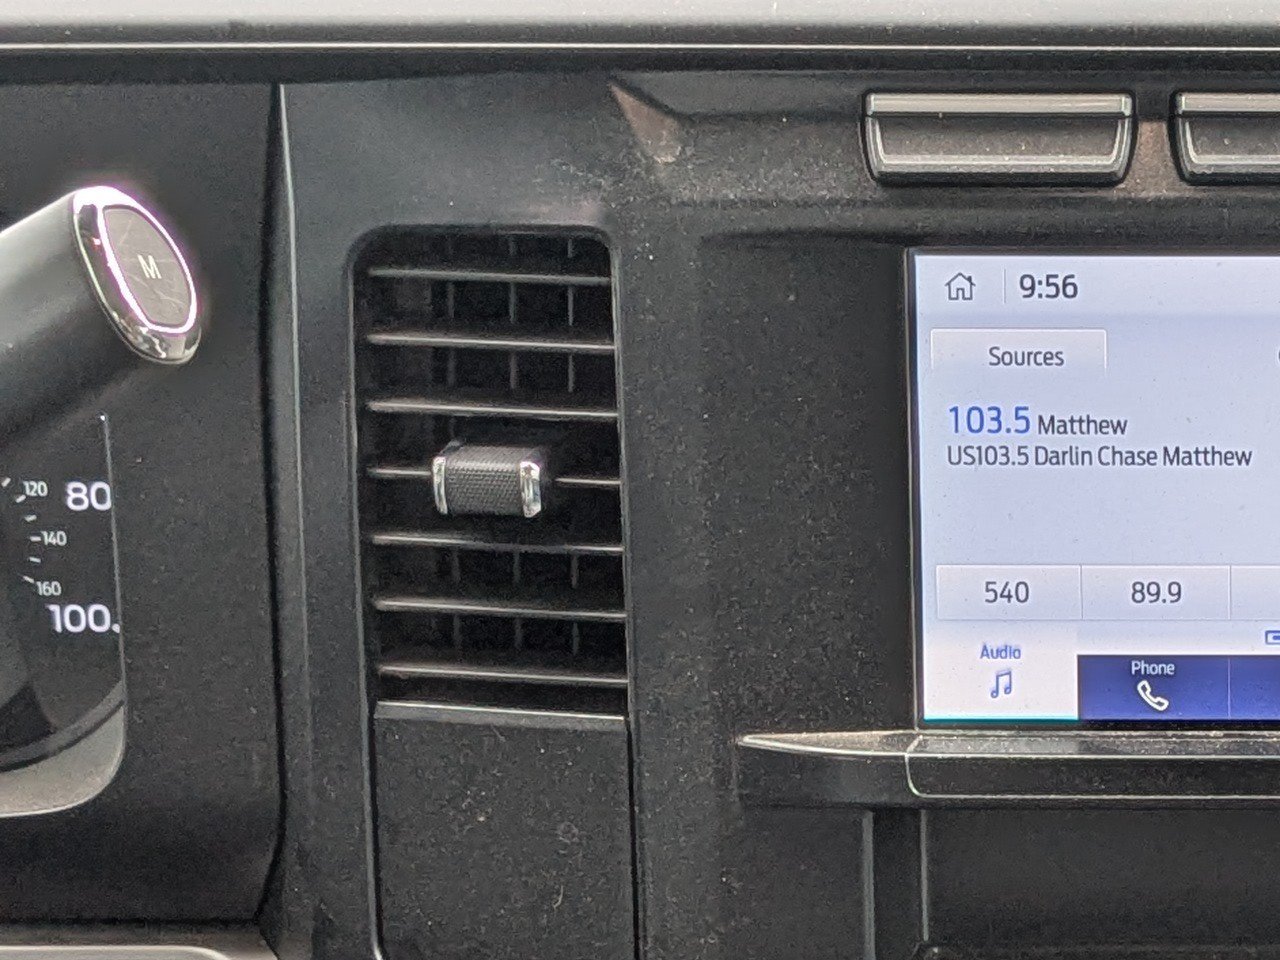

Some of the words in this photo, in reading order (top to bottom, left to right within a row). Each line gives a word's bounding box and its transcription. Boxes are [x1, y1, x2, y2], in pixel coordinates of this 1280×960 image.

[137, 254, 162, 279] M
[1019, 274, 1079, 300] 9:56
[988, 346, 1065, 368] Sources
[948, 406, 1031, 435] 103.5
[1037, 415, 1128, 436] Matthew
[946, 446, 1030, 467] US103.5
[1034, 446, 1092, 467] Darlin
[1097, 446, 1158, 467] Chase
[1162, 446, 1252, 467] Matthew
[23, 481, 48, 496] 120
[66, 481, 112, 511] 80
[41, 531, 67, 545] 140
[36, 581, 61, 596] 160
[984, 582, 1030, 604] 540
[1130, 582, 1183, 604] 89.9
[980, 645, 1022, 661] Audio
[1131, 660, 1175, 677] Phone
